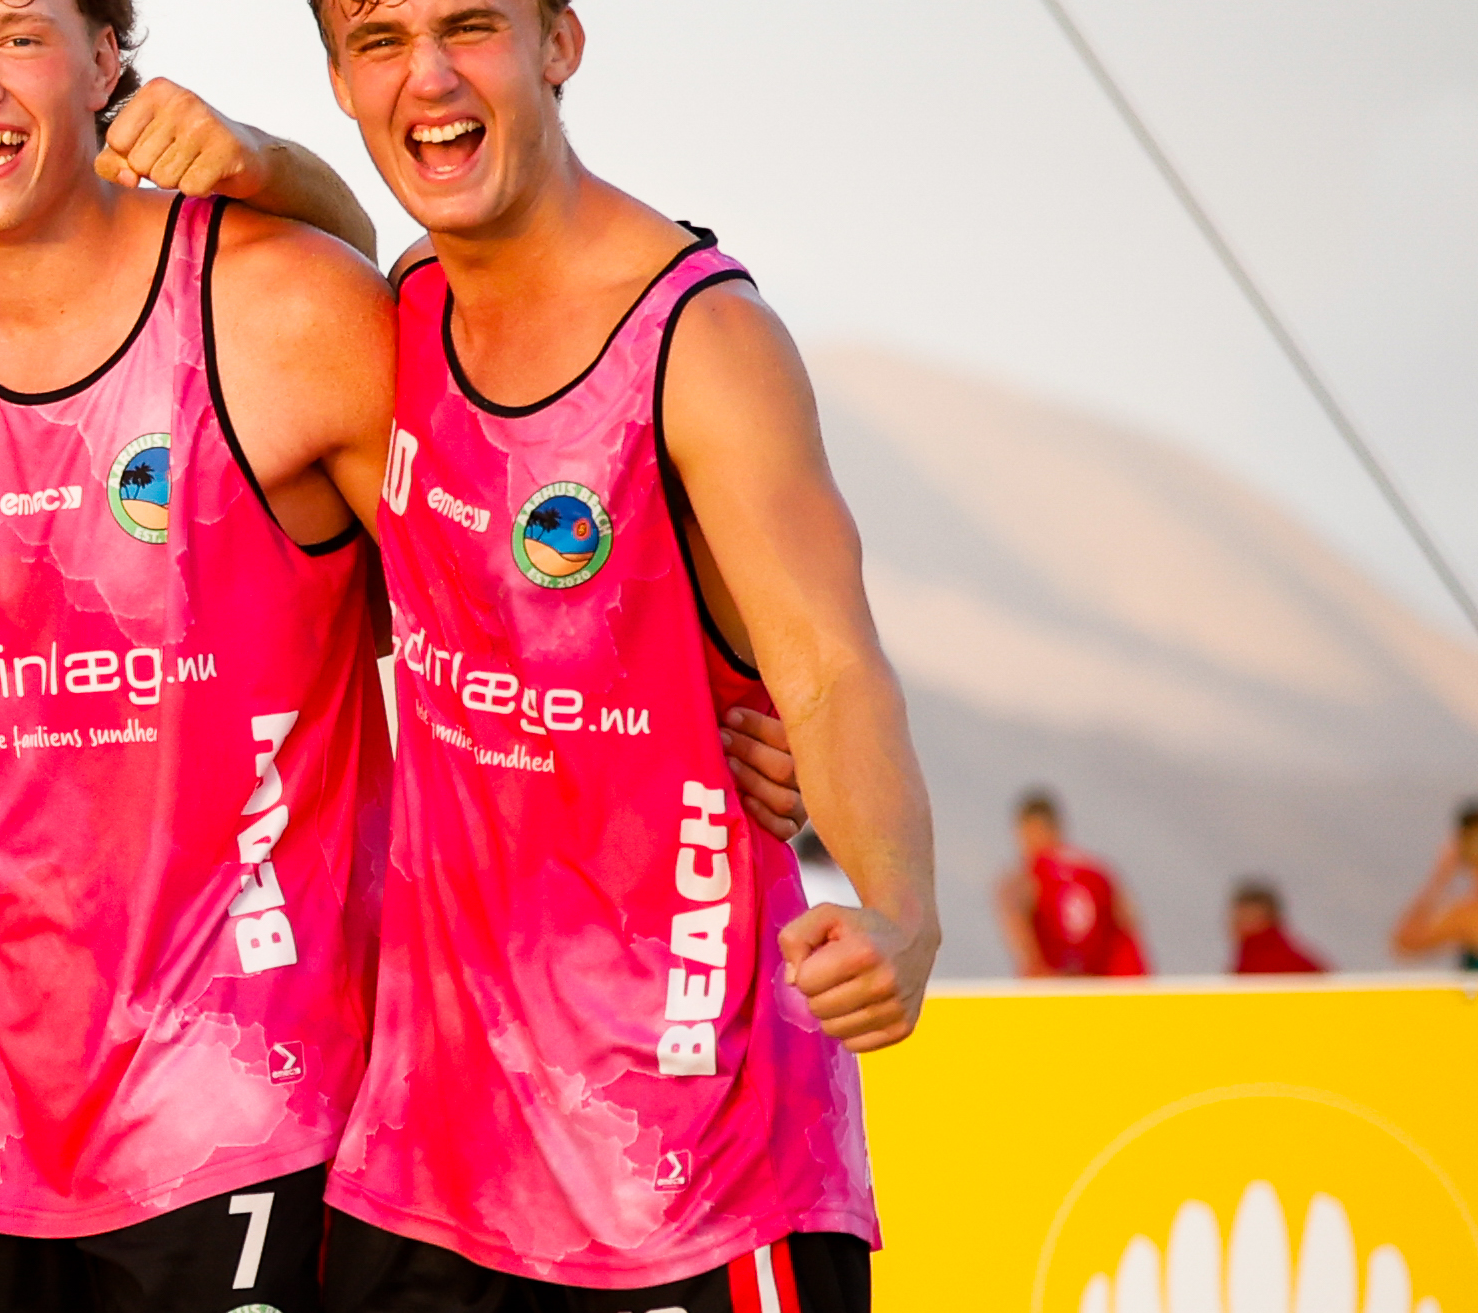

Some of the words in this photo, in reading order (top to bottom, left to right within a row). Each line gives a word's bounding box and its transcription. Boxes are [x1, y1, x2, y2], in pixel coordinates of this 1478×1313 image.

[109, 433, 165, 489] AARHUS
[427, 487, 474, 530] emec
[517, 481, 577, 526] AARHUS
[557, 569, 592, 589] 2020
[658, 778, 734, 1077] BEACH
[228, 1192, 275, 1290] 7
